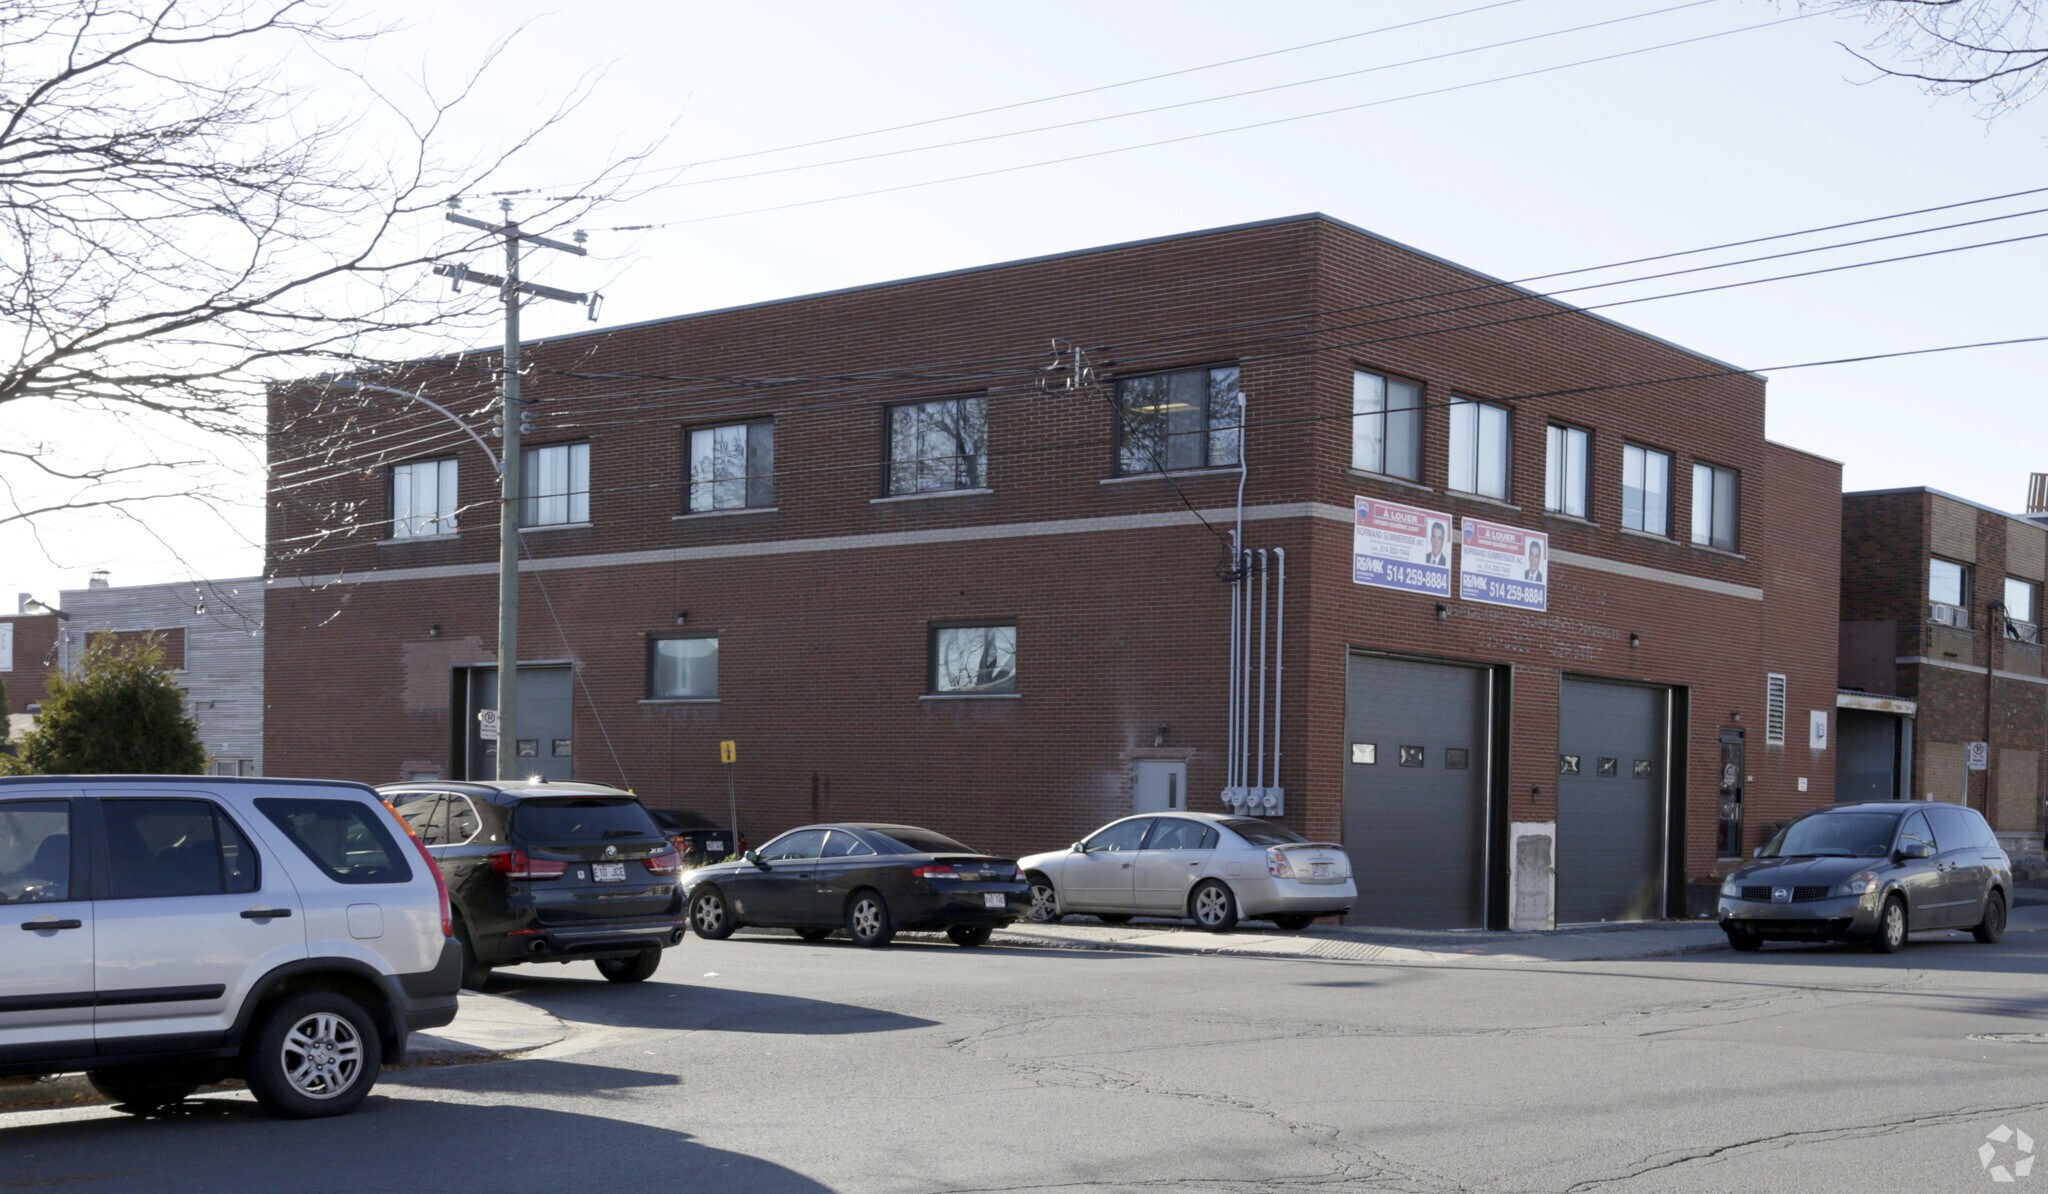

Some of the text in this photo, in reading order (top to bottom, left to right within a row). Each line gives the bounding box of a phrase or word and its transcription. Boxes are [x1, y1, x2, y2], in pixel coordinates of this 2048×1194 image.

[1391, 511, 1417, 523] LOUER
[1356, 527, 1382, 539] NORMAND
[1384, 531, 1416, 545] SUMMERSIDE
[1492, 532, 1515, 541] LOUER
[1357, 557, 1384, 573] RE/MAX
[1386, 564, 1447, 589] 514 259-8884
[1489, 581, 1505, 599] 514
[1507, 585, 1543, 604] 259-8884
